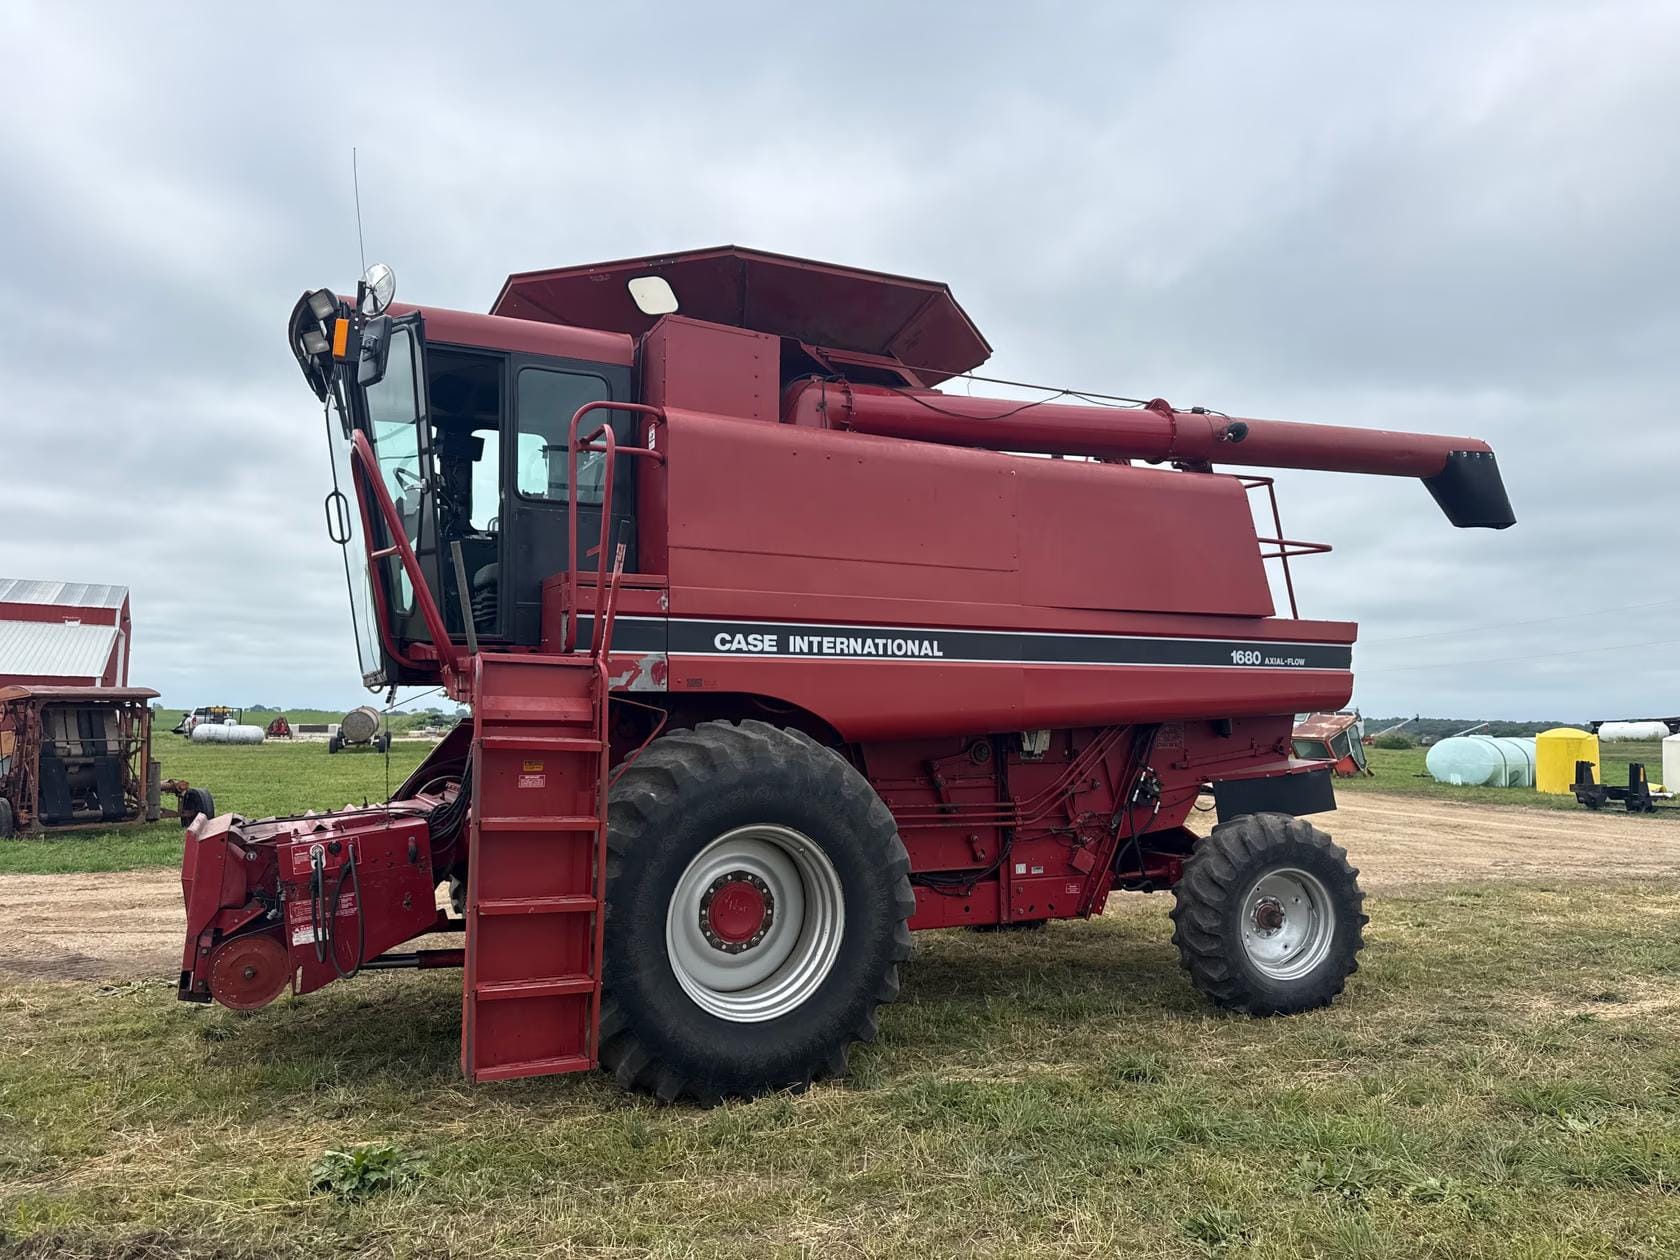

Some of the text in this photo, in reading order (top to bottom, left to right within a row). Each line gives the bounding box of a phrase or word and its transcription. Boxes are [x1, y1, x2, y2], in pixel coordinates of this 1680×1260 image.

[714, 632, 943, 657] CASE INTERNATIONAL
[1230, 650, 1305, 666] 1680 AXIAL-FLOW
